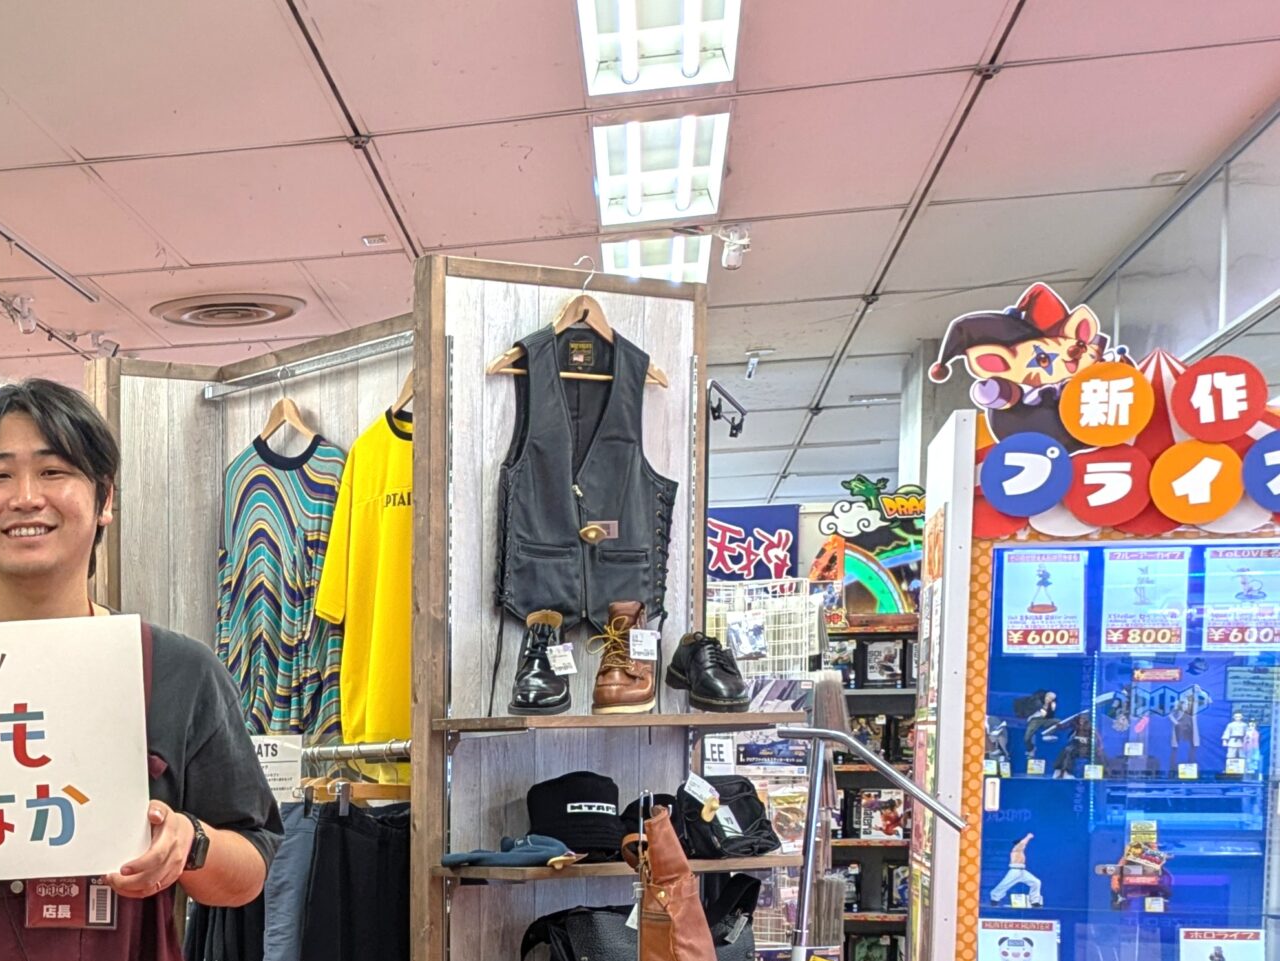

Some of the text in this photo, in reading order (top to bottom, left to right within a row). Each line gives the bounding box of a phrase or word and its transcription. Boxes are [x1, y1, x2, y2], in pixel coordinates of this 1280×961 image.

[1078, 371, 1249, 428] 新作
[256, 743, 278, 758] ATS
[42, 903, 72, 919] 店長
